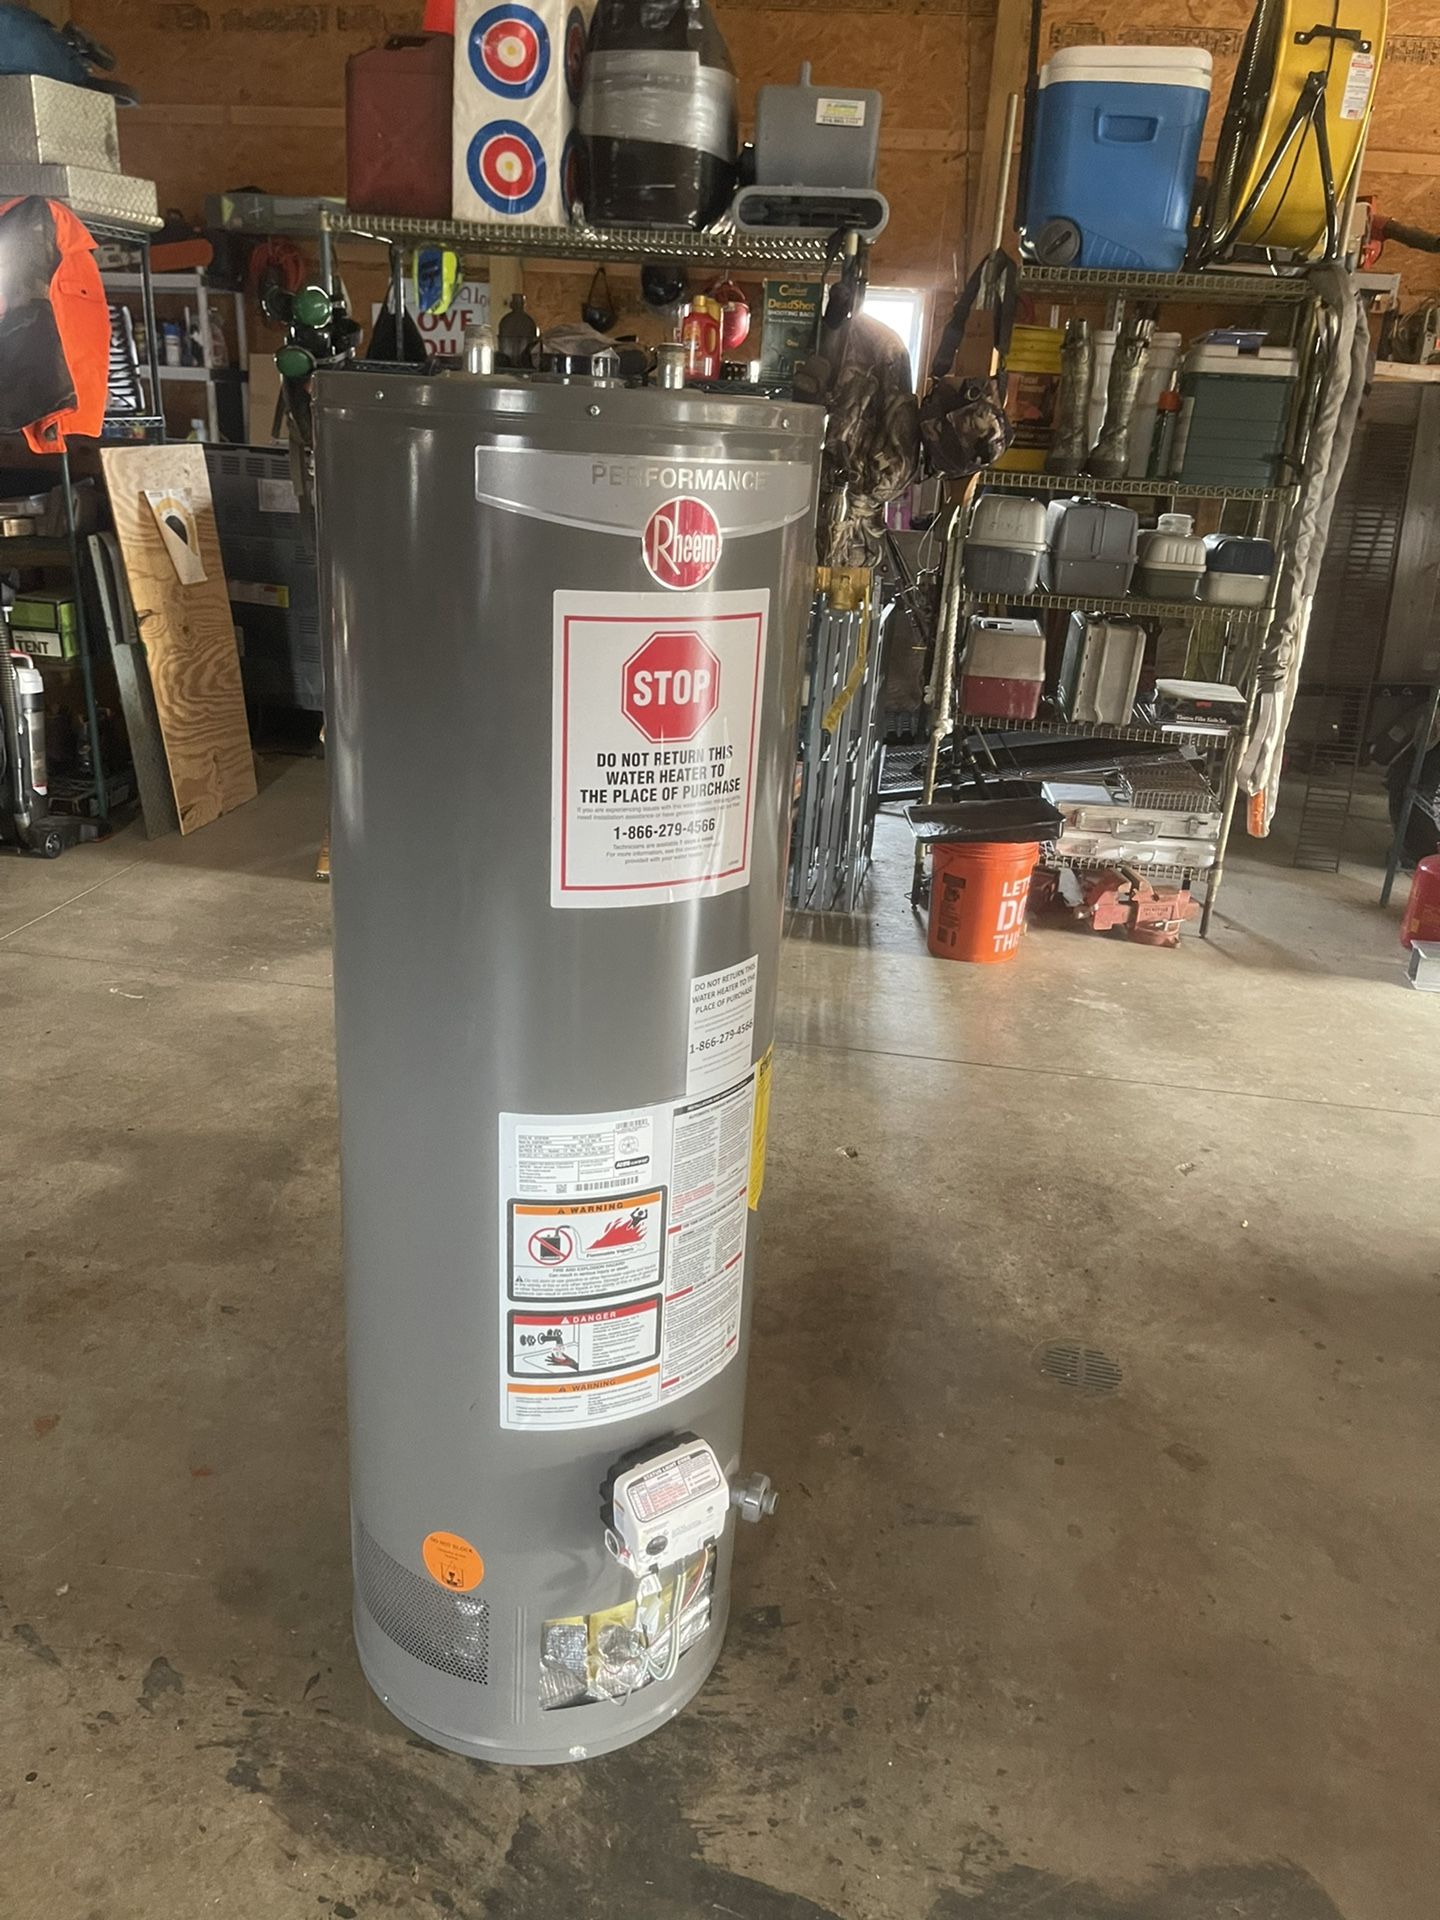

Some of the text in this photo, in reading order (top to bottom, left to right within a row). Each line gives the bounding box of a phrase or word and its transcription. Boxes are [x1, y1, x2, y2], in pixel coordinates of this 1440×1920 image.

[767, 298, 816, 311] DeadShot
[417, 309, 473, 332] OVE
[591, 464, 770, 491] PERFORMANCE
[652, 501, 716, 576] Rheem
[16, 639, 49, 654] TENT
[632, 669, 711, 707] STOP
[596, 745, 733, 768] DO NOT RETURN THIS
[606, 763, 725, 786] WATER HEATER TO
[580, 789, 608, 804] THE
[613, 788, 657, 804] PLACE
[661, 786, 679, 801] OF
[682, 778, 741, 800] PURCHASE
[613, 818, 716, 840] 1-866-279-4566
[1002, 876, 1031, 897] LET
[993, 929, 1020, 953] THI
[692, 973, 756, 1004] WATER HEATER TO THE
[694, 963, 756, 992] DO NOT RETURN THIS
[695, 985, 753, 1014] PLACE OF PURCHASE
[689, 1019, 753, 1054] 1-866-279-4566
[569, 1202, 624, 1215] WARNING
[573, 1311, 617, 1324] DANGER
[571, 1380, 617, 1392] WARNING
